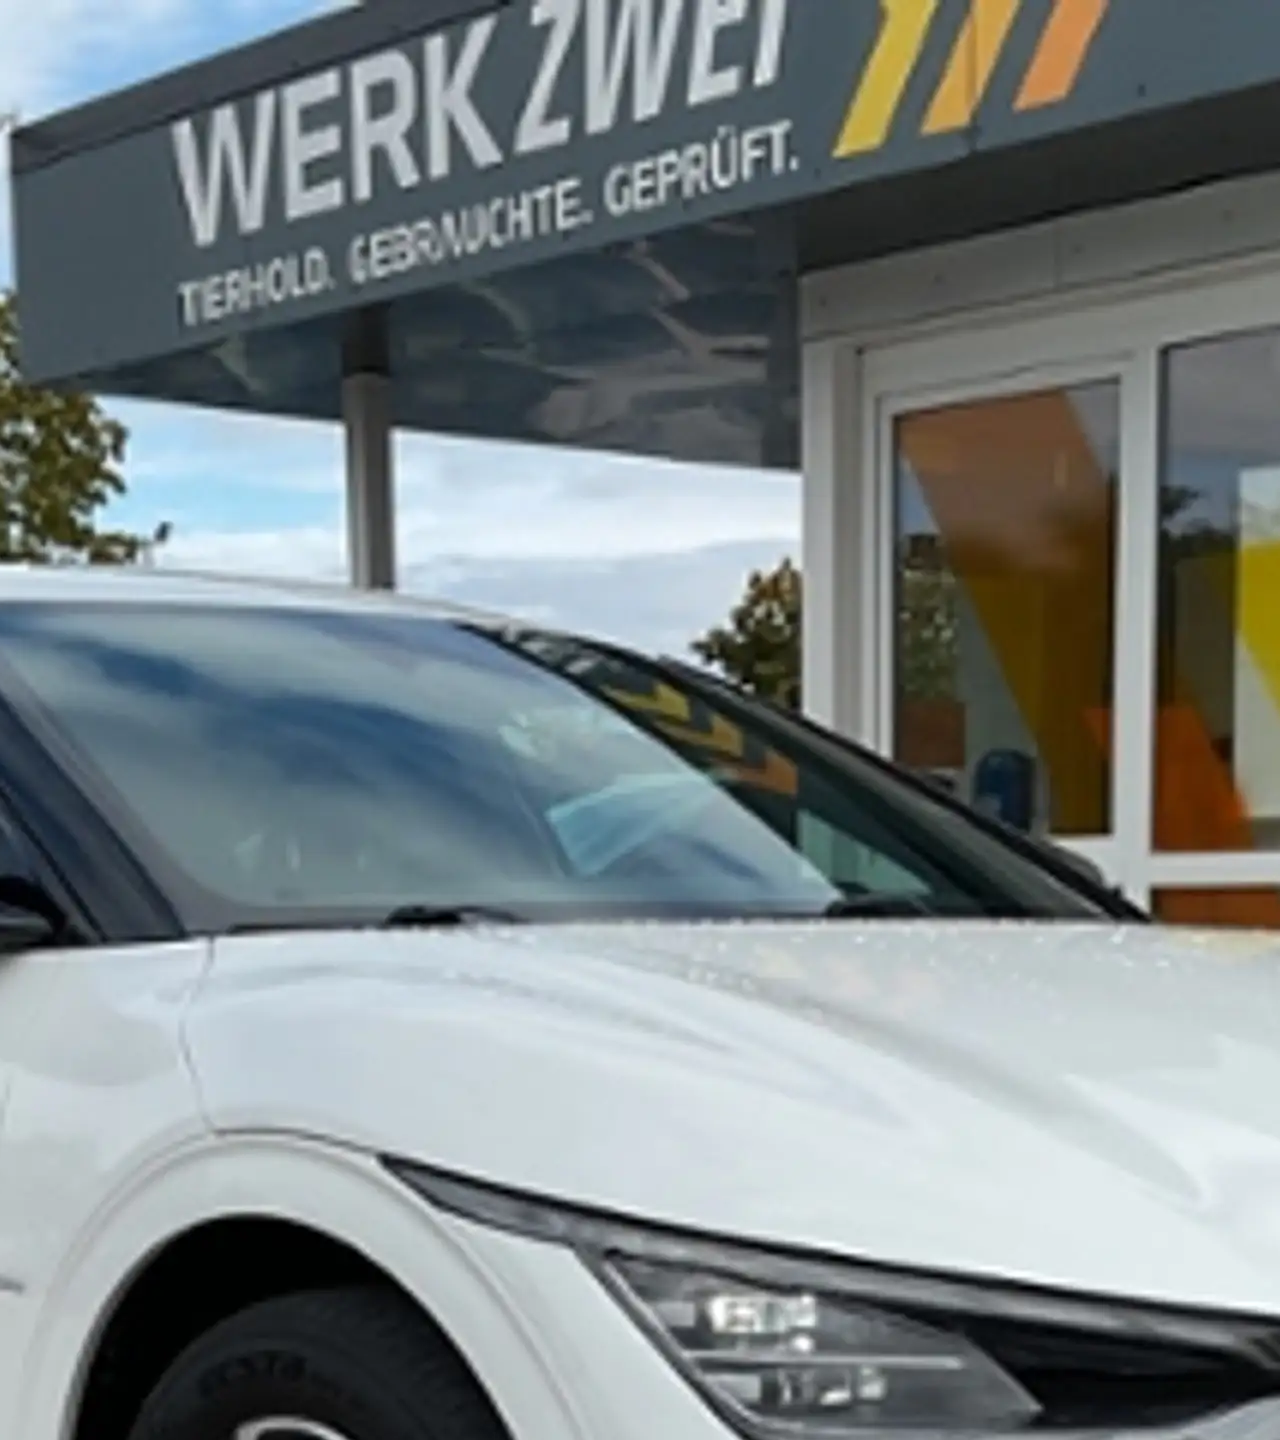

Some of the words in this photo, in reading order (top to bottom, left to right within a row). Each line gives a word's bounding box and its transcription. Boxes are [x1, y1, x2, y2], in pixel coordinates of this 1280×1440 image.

[172, 13, 503, 248] WERK
[349, 178, 593, 284] GEBRAUCHTE.
[608, 119, 800, 217] GEPRÜFT.
